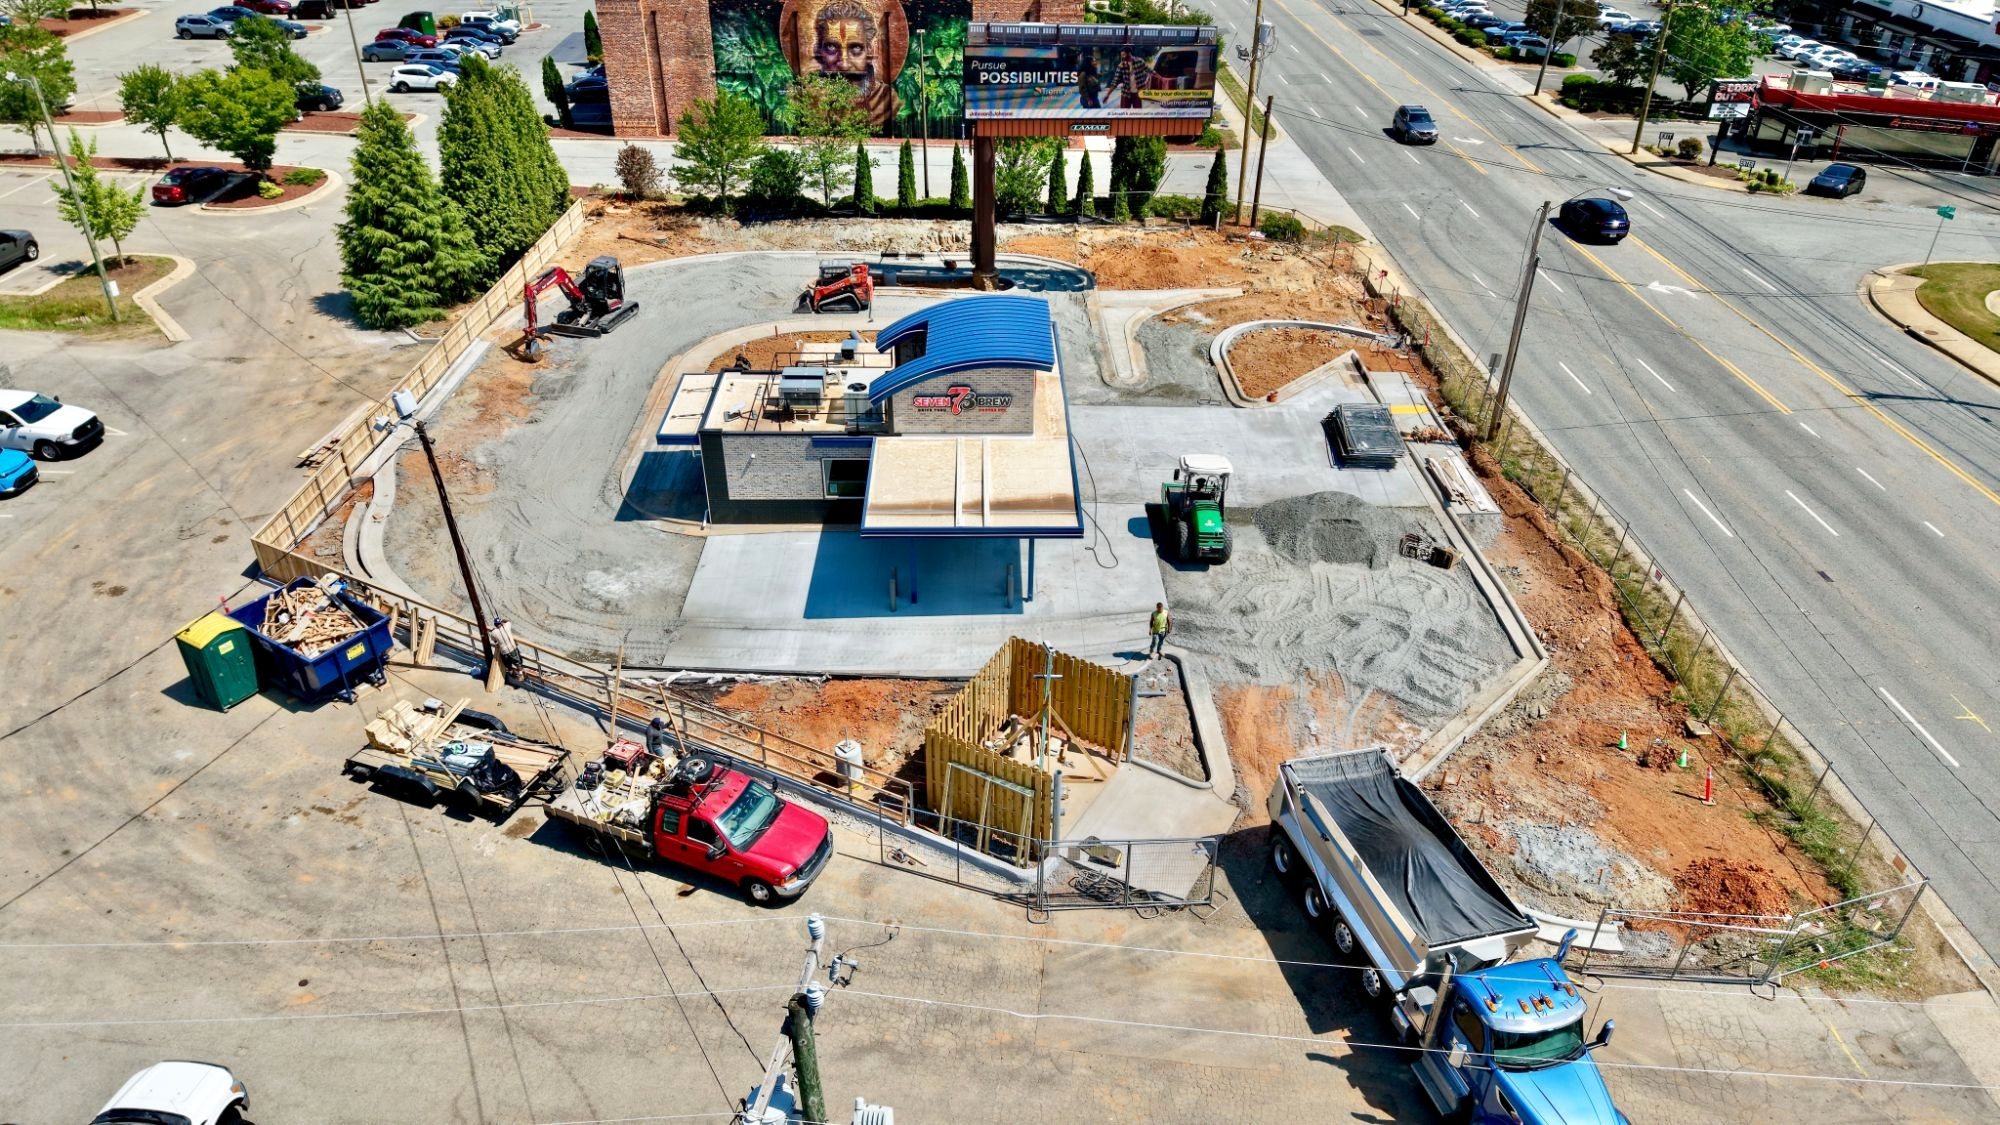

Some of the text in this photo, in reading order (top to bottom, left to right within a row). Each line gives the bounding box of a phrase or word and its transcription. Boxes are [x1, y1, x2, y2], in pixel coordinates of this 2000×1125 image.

[971, 60, 1007, 70] Pursue
[980, 71, 1079, 84] POSSIBILITIES
[1727, 83, 1755, 93] COOK
[1714, 92, 1737, 102] OUT
[913, 396, 951, 407] SEVEN
[977, 396, 1011, 407] BREW
